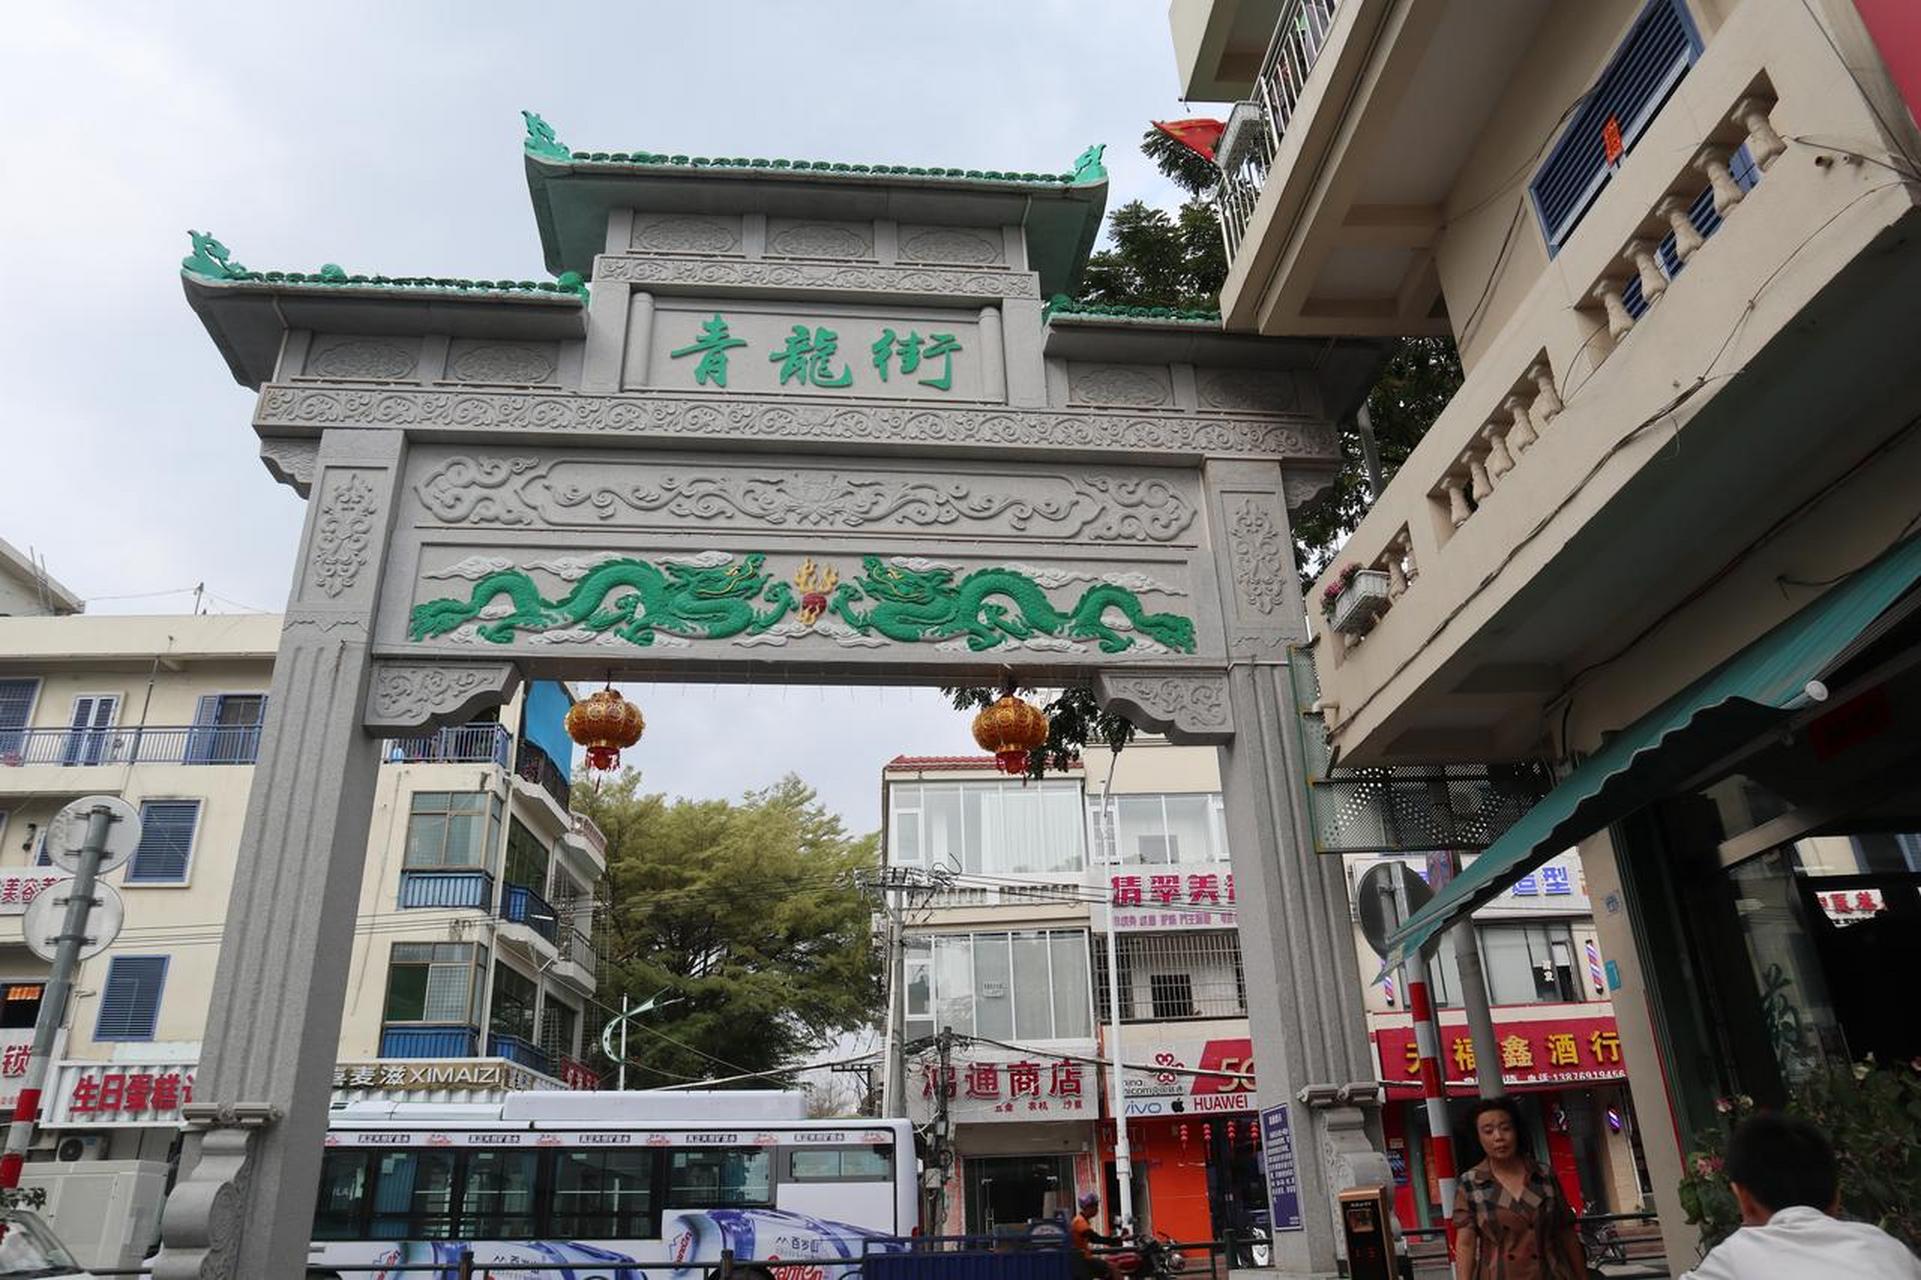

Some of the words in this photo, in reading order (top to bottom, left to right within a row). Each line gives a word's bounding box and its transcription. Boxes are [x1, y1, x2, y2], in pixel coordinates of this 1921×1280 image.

[669, 312, 963, 392] 青龍街
[410, 1067, 500, 1083] XIMAIZI
[1193, 1095, 1249, 1111] HUAWEI
